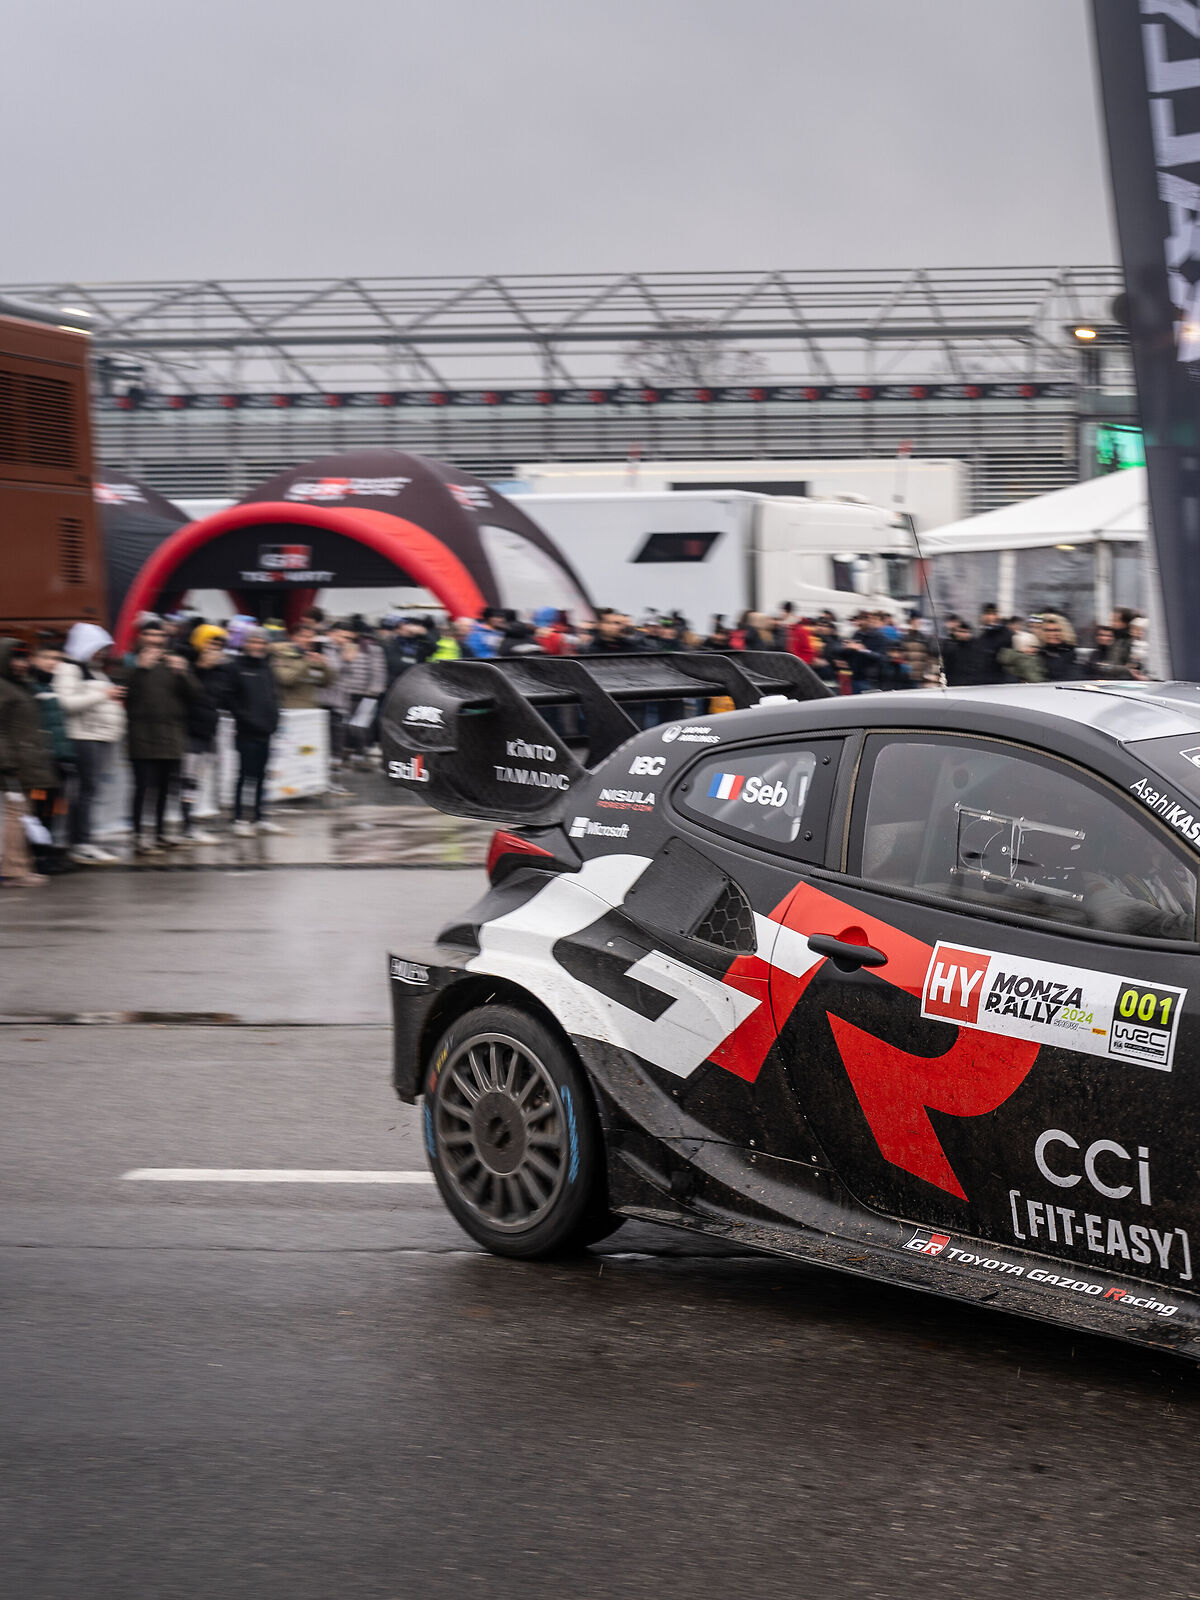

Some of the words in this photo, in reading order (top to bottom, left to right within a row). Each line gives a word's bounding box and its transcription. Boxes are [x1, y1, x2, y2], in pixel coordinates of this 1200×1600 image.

[493, 765, 570, 791] TAMADIC
[742, 776, 788, 808] Seb
[599, 788, 656, 805] NISULA
[587, 819, 630, 839] Microsoft
[929, 962, 985, 1008] HY
[992, 972, 1083, 1009] MONZA
[985, 994, 1062, 1025] RALLY
[1061, 1007, 1094, 1025] 2024
[1119, 990, 1173, 1025] 001
[1114, 1025, 1168, 1048] WRC
[906, 1238, 944, 1256] GR
[947, 1247, 1026, 1276] TOYOTA
[1027, 1268, 1104, 1296] GAZOO
[1103, 1287, 1179, 1317] Racing
